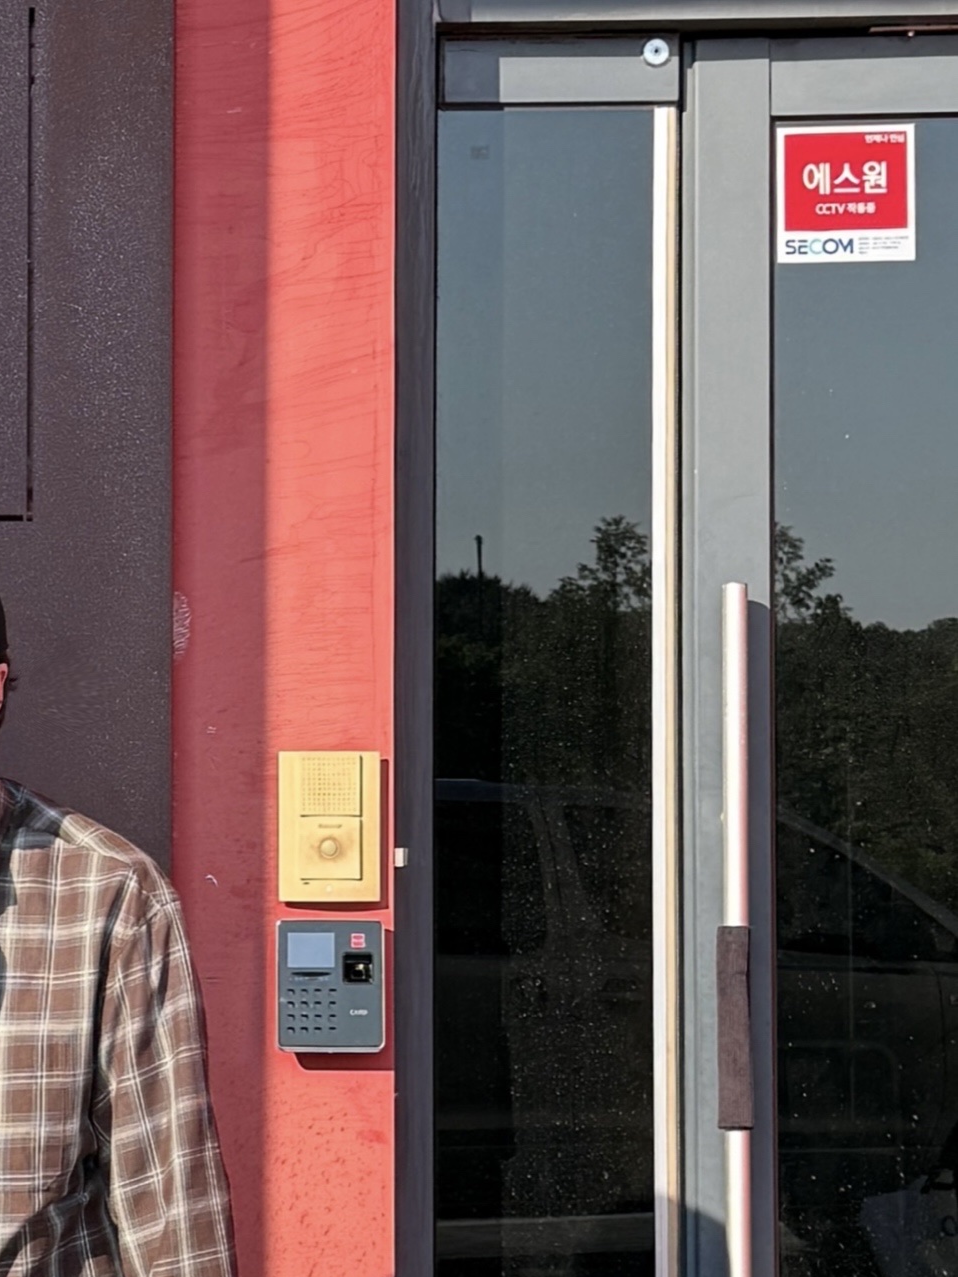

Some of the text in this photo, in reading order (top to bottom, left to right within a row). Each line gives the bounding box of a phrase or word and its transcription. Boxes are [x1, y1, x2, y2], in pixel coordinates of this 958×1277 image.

[802, 161, 888, 195] 에스원
[815, 203, 845, 215] CCTV
[785, 238, 854, 255] SECOM
